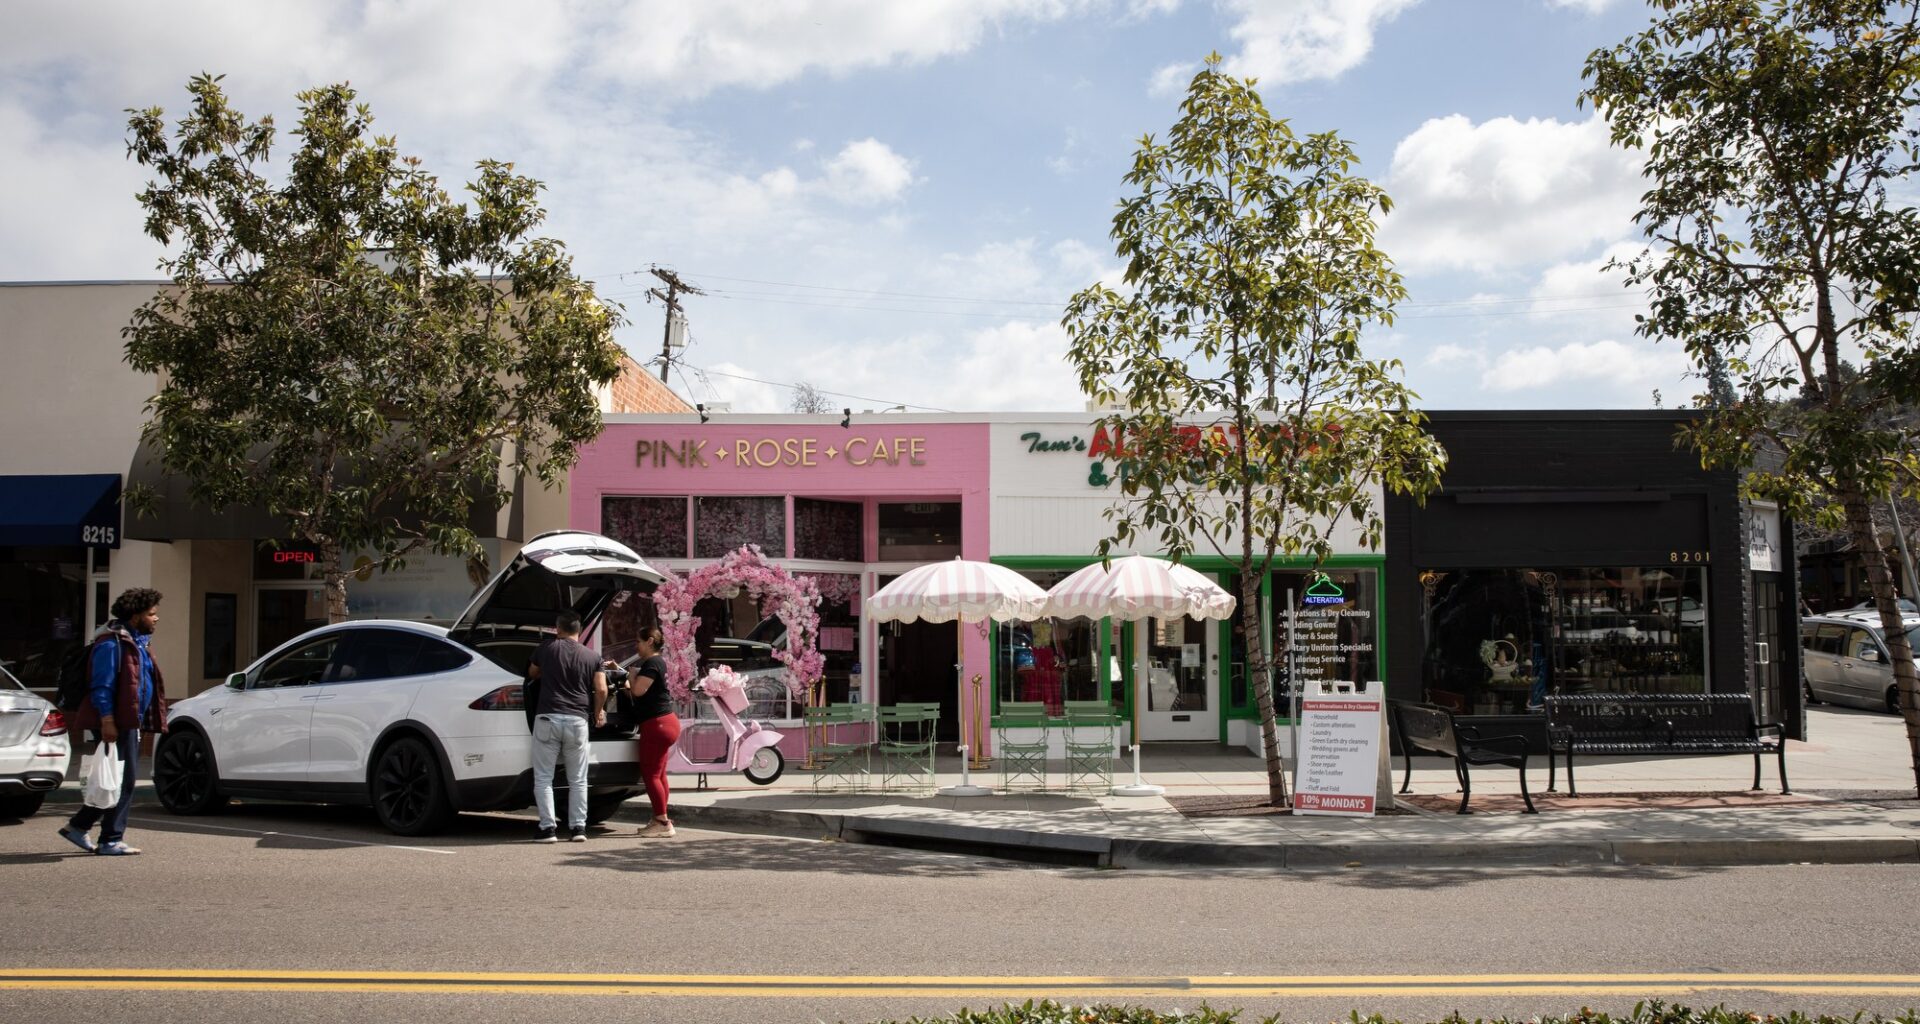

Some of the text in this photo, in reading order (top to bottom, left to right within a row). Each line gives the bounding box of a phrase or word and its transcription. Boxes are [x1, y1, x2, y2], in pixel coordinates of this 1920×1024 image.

[1020, 432, 1086, 453] Tam's
[635, 437, 926, 468] PINK ROSE CAFE
[1088, 461, 1108, 486] &
[83, 525, 114, 544] 8215
[274, 551, 314, 562] OPEN
[1670, 552, 1710, 562] 8201
[1327, 610, 1339, 618] Dry
[1340, 609, 1370, 618] Cleaning
[1313, 621, 1336, 629] Gowns
[1316, 632, 1338, 640] Suede
[1311, 643, 1339, 651] Uniform
[1340, 643, 1372, 653] Specialist
[1321, 655, 1346, 663] Service
[1301, 667, 1324, 676] Repair
[1301, 794, 1366, 809] 10% MONDAYS
